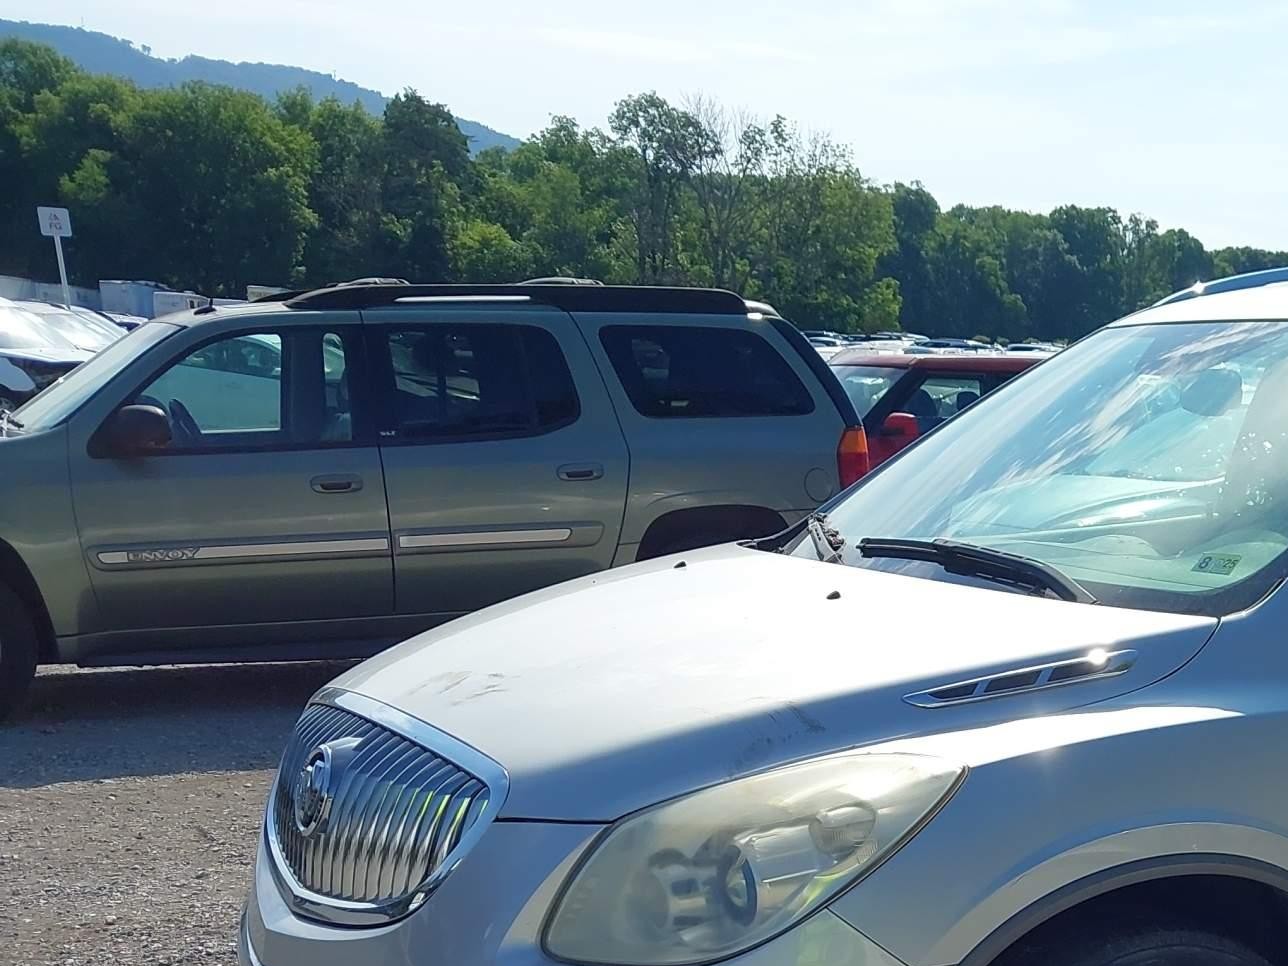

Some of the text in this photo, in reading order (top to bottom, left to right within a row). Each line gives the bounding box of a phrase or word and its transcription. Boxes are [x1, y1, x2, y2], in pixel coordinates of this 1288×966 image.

[126, 546, 200, 561] ENVOY
[1199, 556, 1212, 569] 8
[1223, 559, 1239, 568] 25
